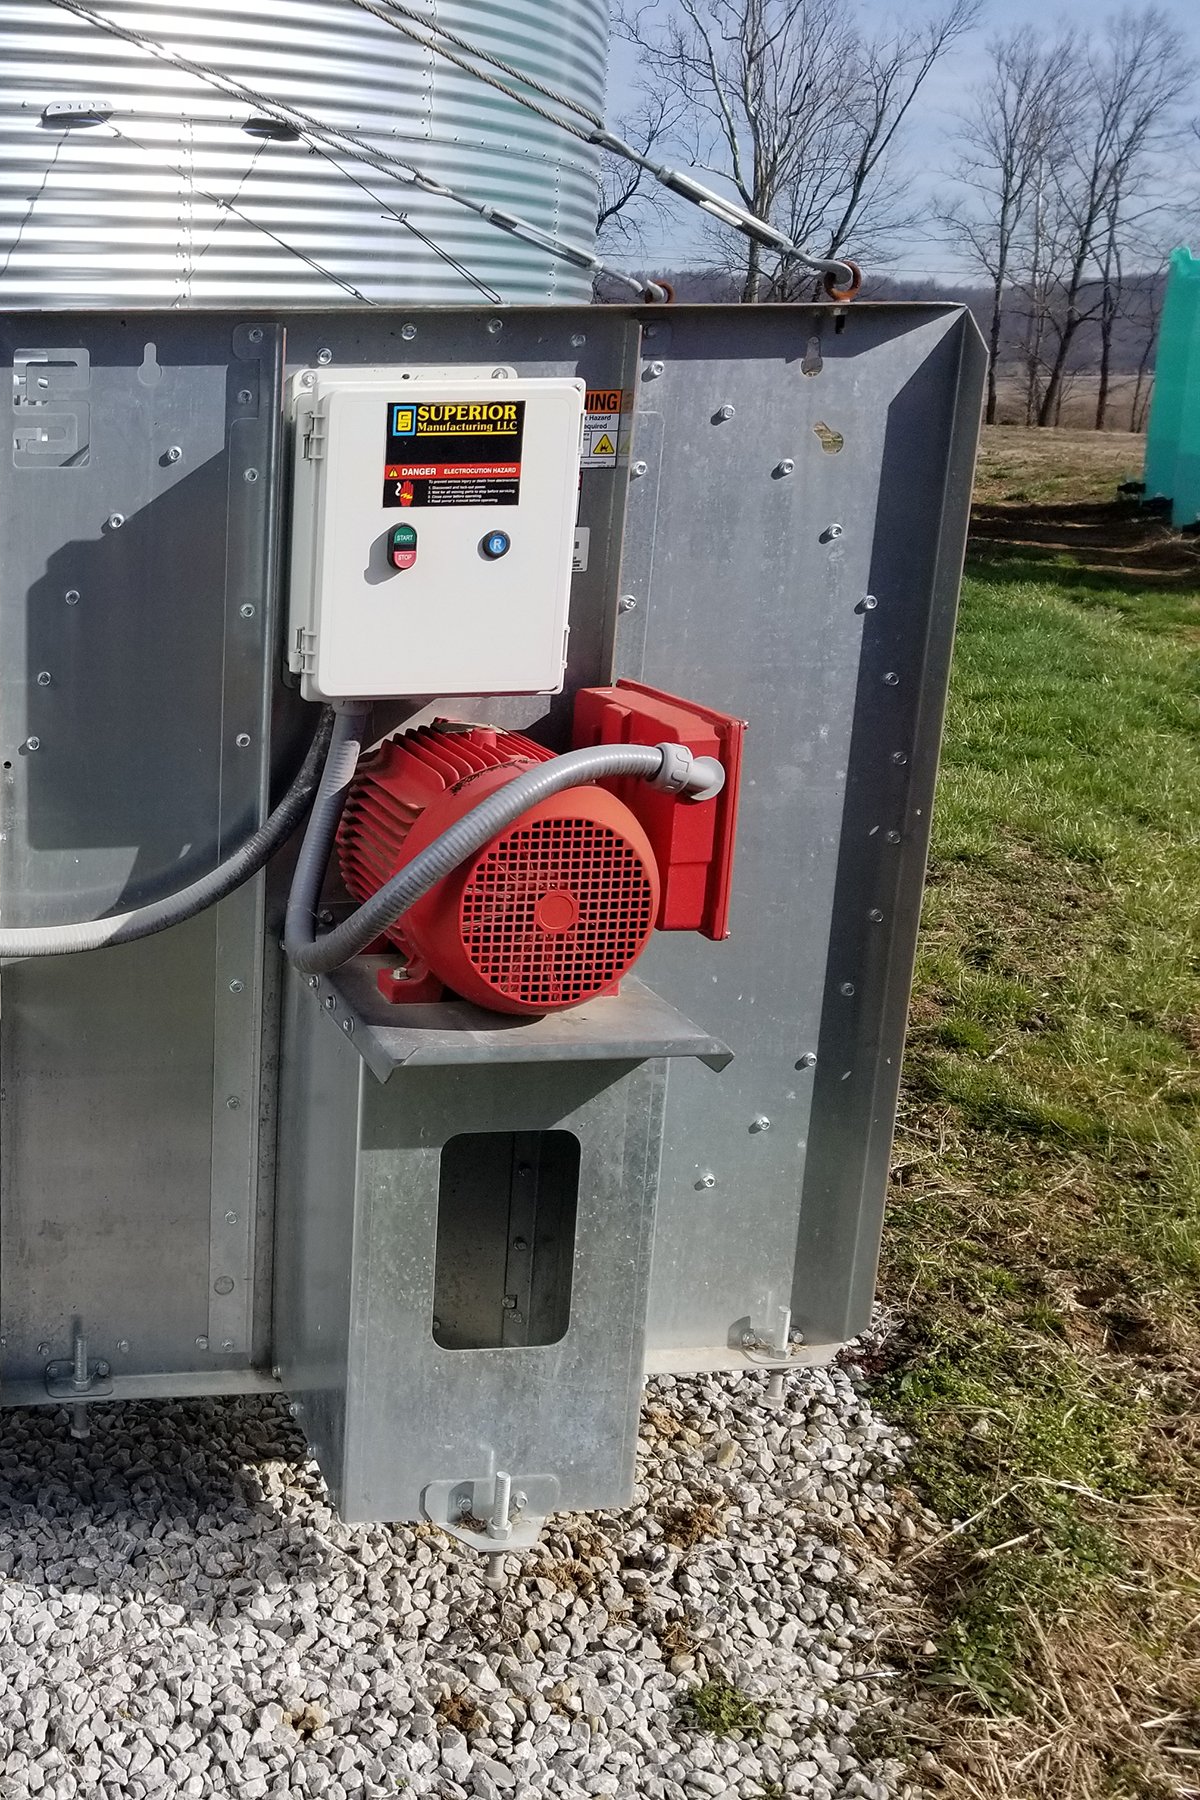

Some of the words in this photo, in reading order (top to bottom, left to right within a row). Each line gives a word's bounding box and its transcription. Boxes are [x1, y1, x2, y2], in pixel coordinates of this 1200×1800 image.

[417, 405, 517, 421] SUPERIOR
[417, 421, 493, 432] Manufacturing
[497, 421, 518, 430] LLC
[402, 468, 437, 476] DANGER
[493, 539, 502, 549] R
